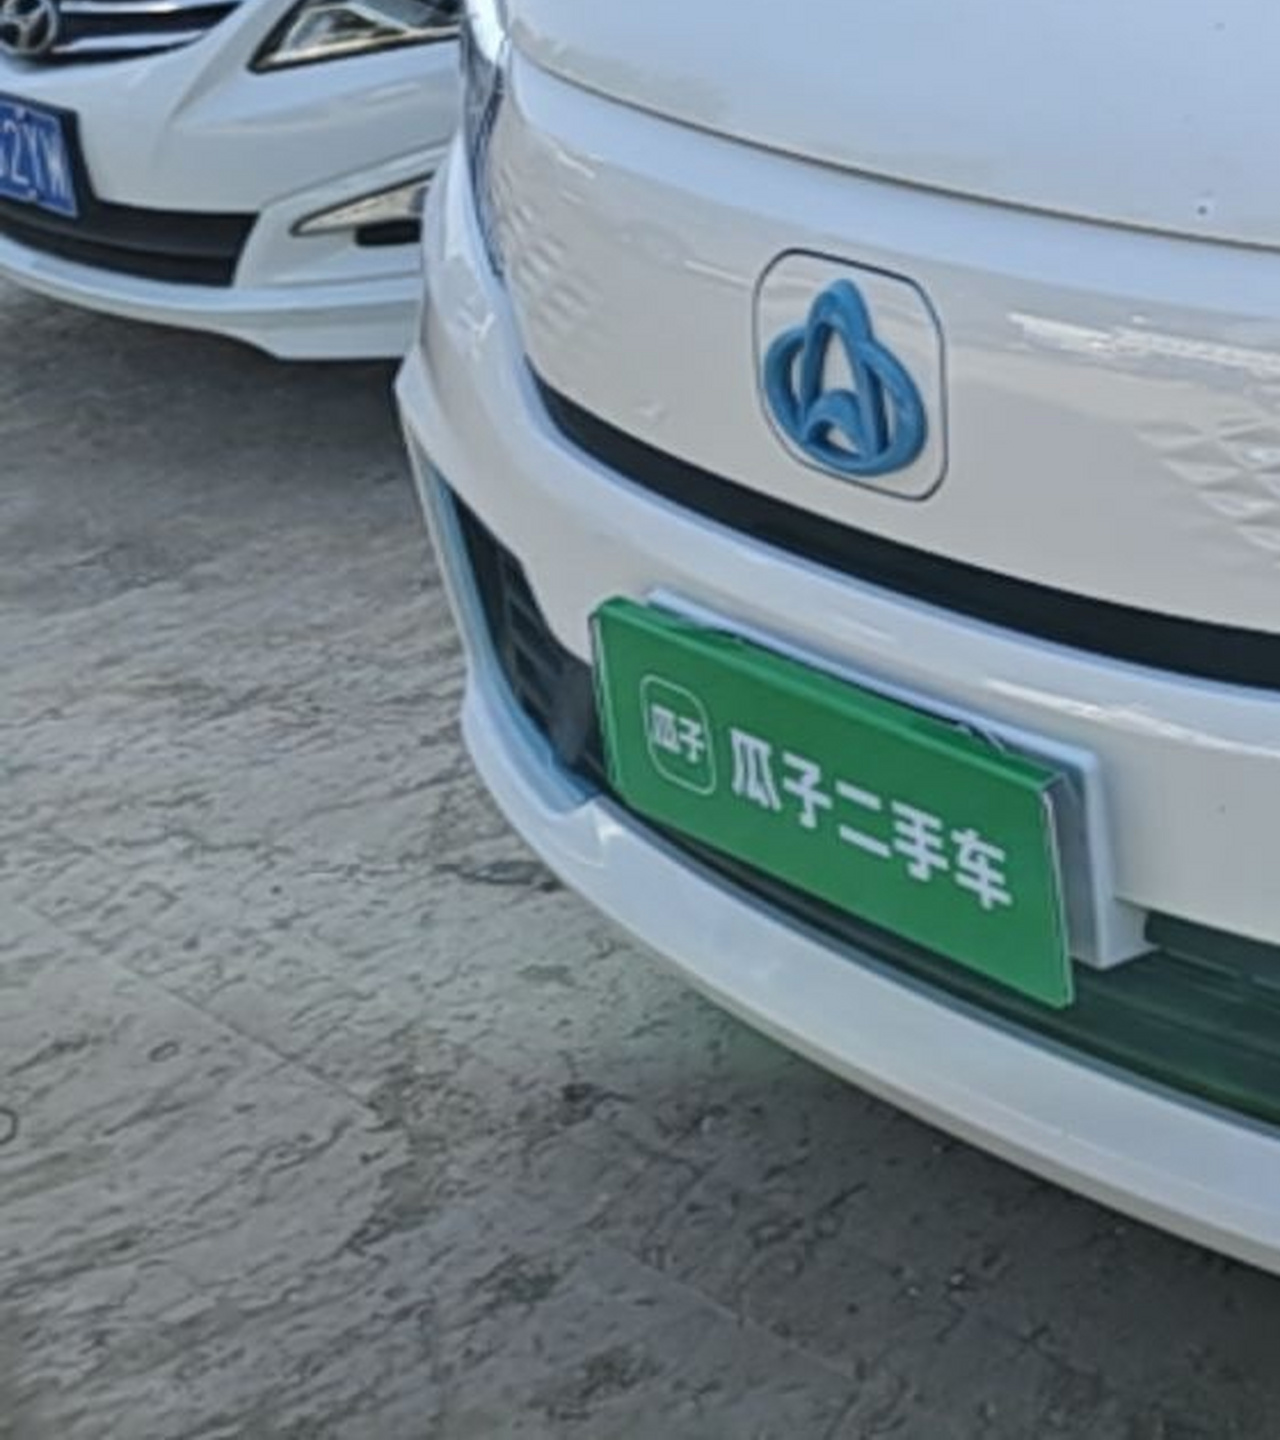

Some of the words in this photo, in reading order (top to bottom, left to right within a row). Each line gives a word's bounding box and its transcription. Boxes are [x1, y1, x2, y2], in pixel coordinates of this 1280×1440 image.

[0, 120, 73, 198] 2YW
[651, 703, 705, 763] 瓜子
[730, 727, 1012, 910] 瓜子二手车
